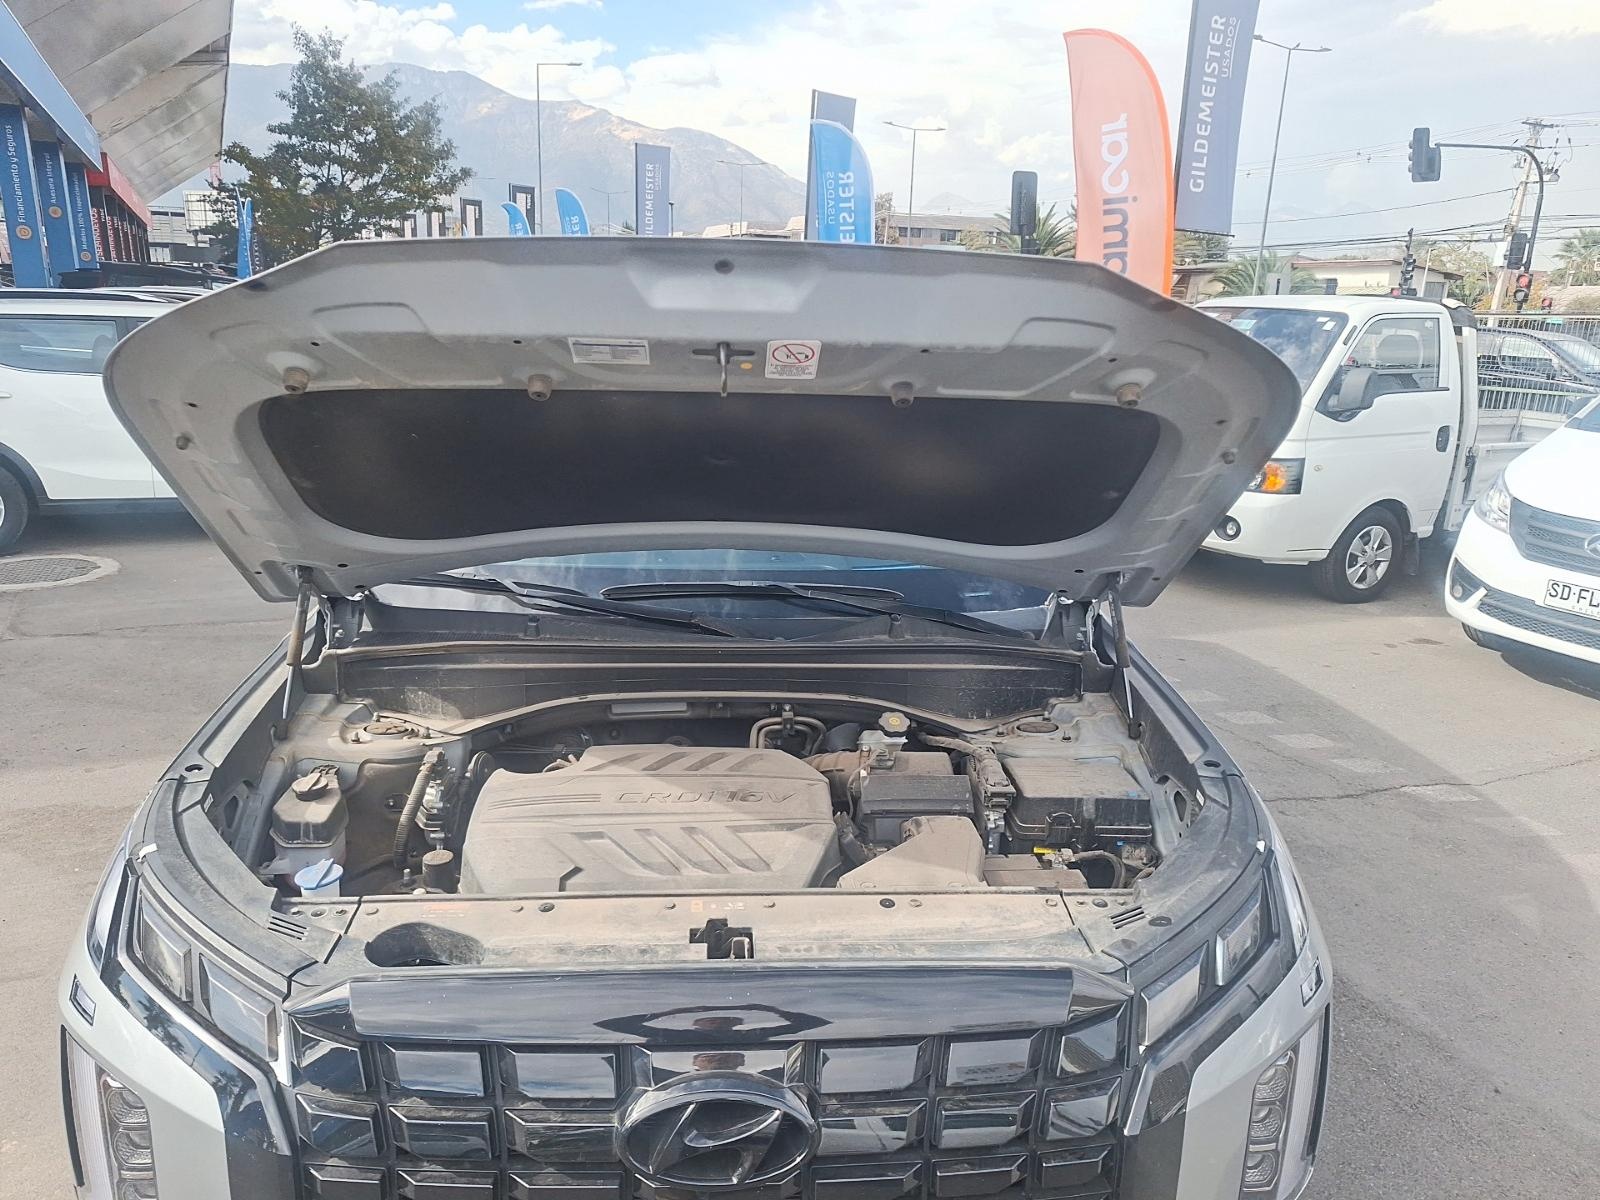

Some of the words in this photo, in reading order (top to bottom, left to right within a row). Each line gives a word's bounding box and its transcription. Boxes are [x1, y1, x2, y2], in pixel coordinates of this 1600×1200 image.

[1221, 16, 1237, 78] USADOS
[1189, 15, 1227, 193] GILDEMEISTER
[5, 125, 16, 155] Seguros
[9, 164, 26, 223] Financiamiento
[645, 163, 654, 237] ILDEMEISTER
